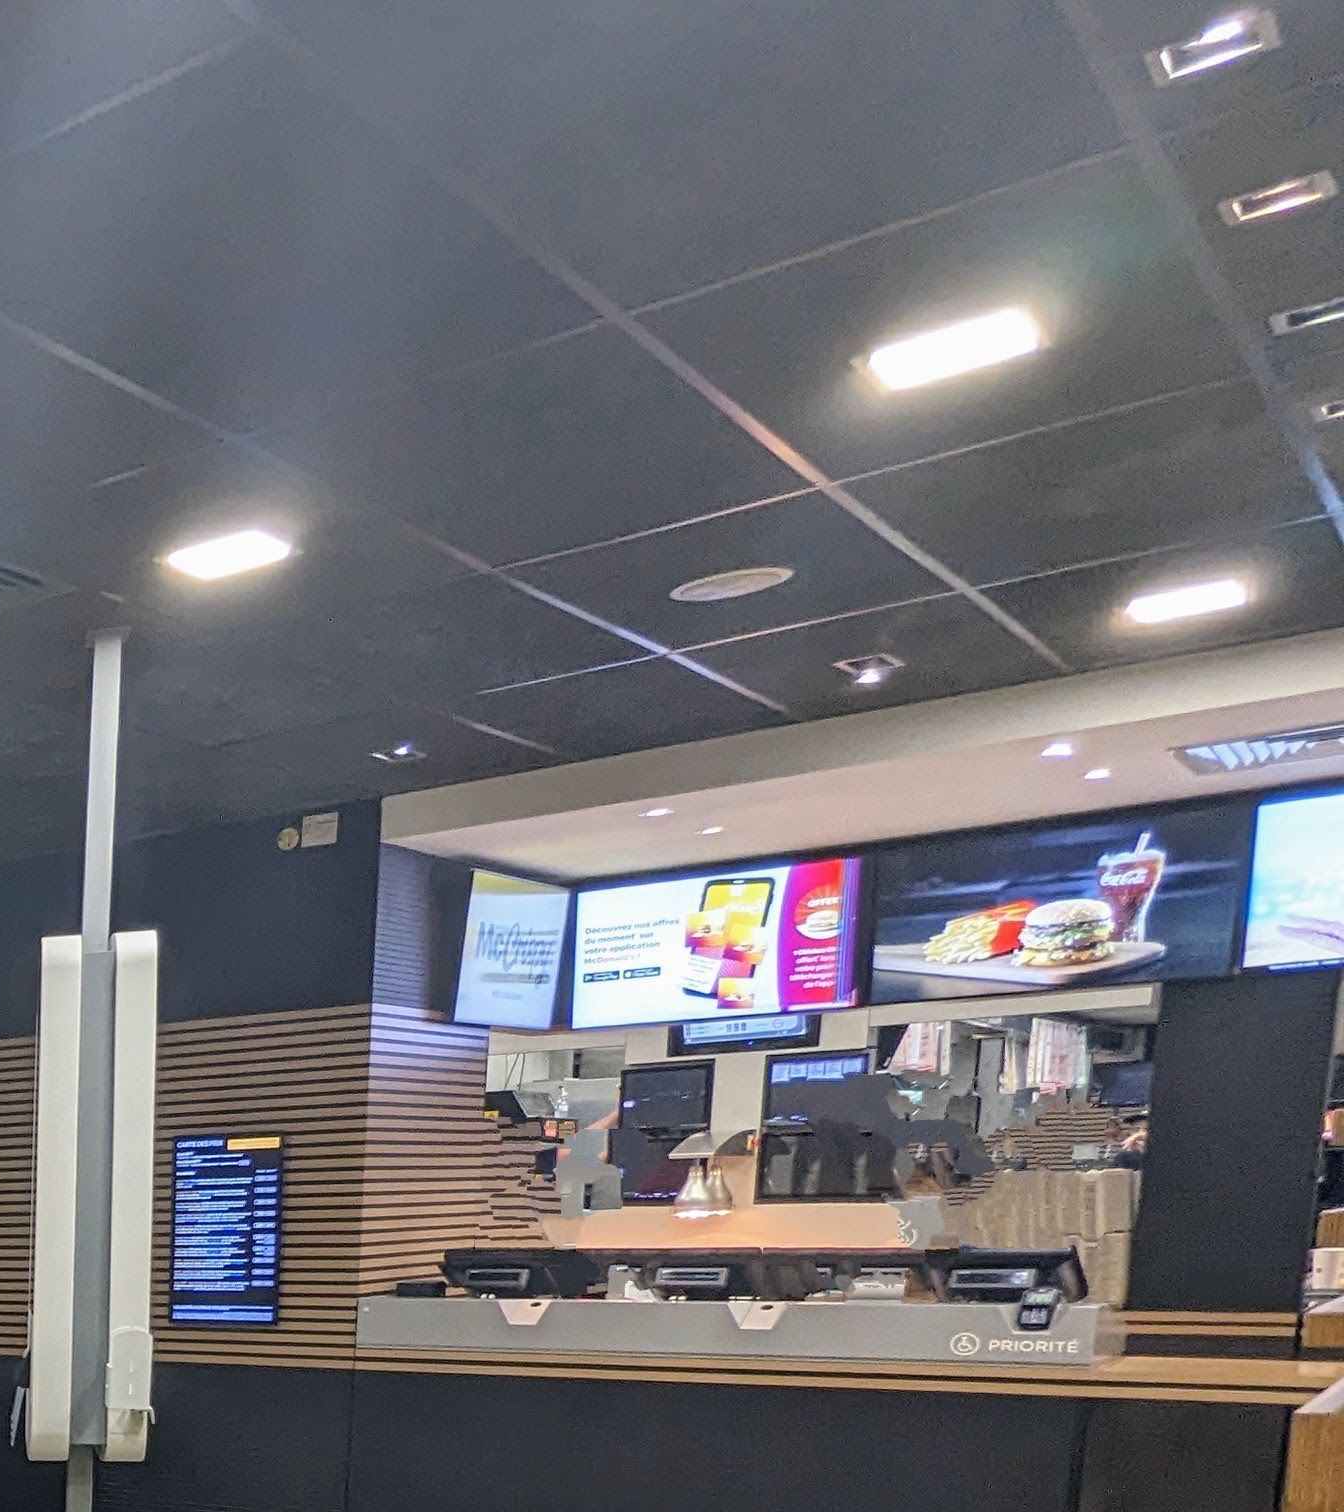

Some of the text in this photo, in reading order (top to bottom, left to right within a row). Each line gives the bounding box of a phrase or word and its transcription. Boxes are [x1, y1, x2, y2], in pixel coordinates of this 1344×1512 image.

[585, 918, 681, 935] Découvrez nos offres
[584, 937, 596, 945] du
[584, 940, 661, 955] votre application
[987, 1338, 1080, 1354] PRIORITÉ
